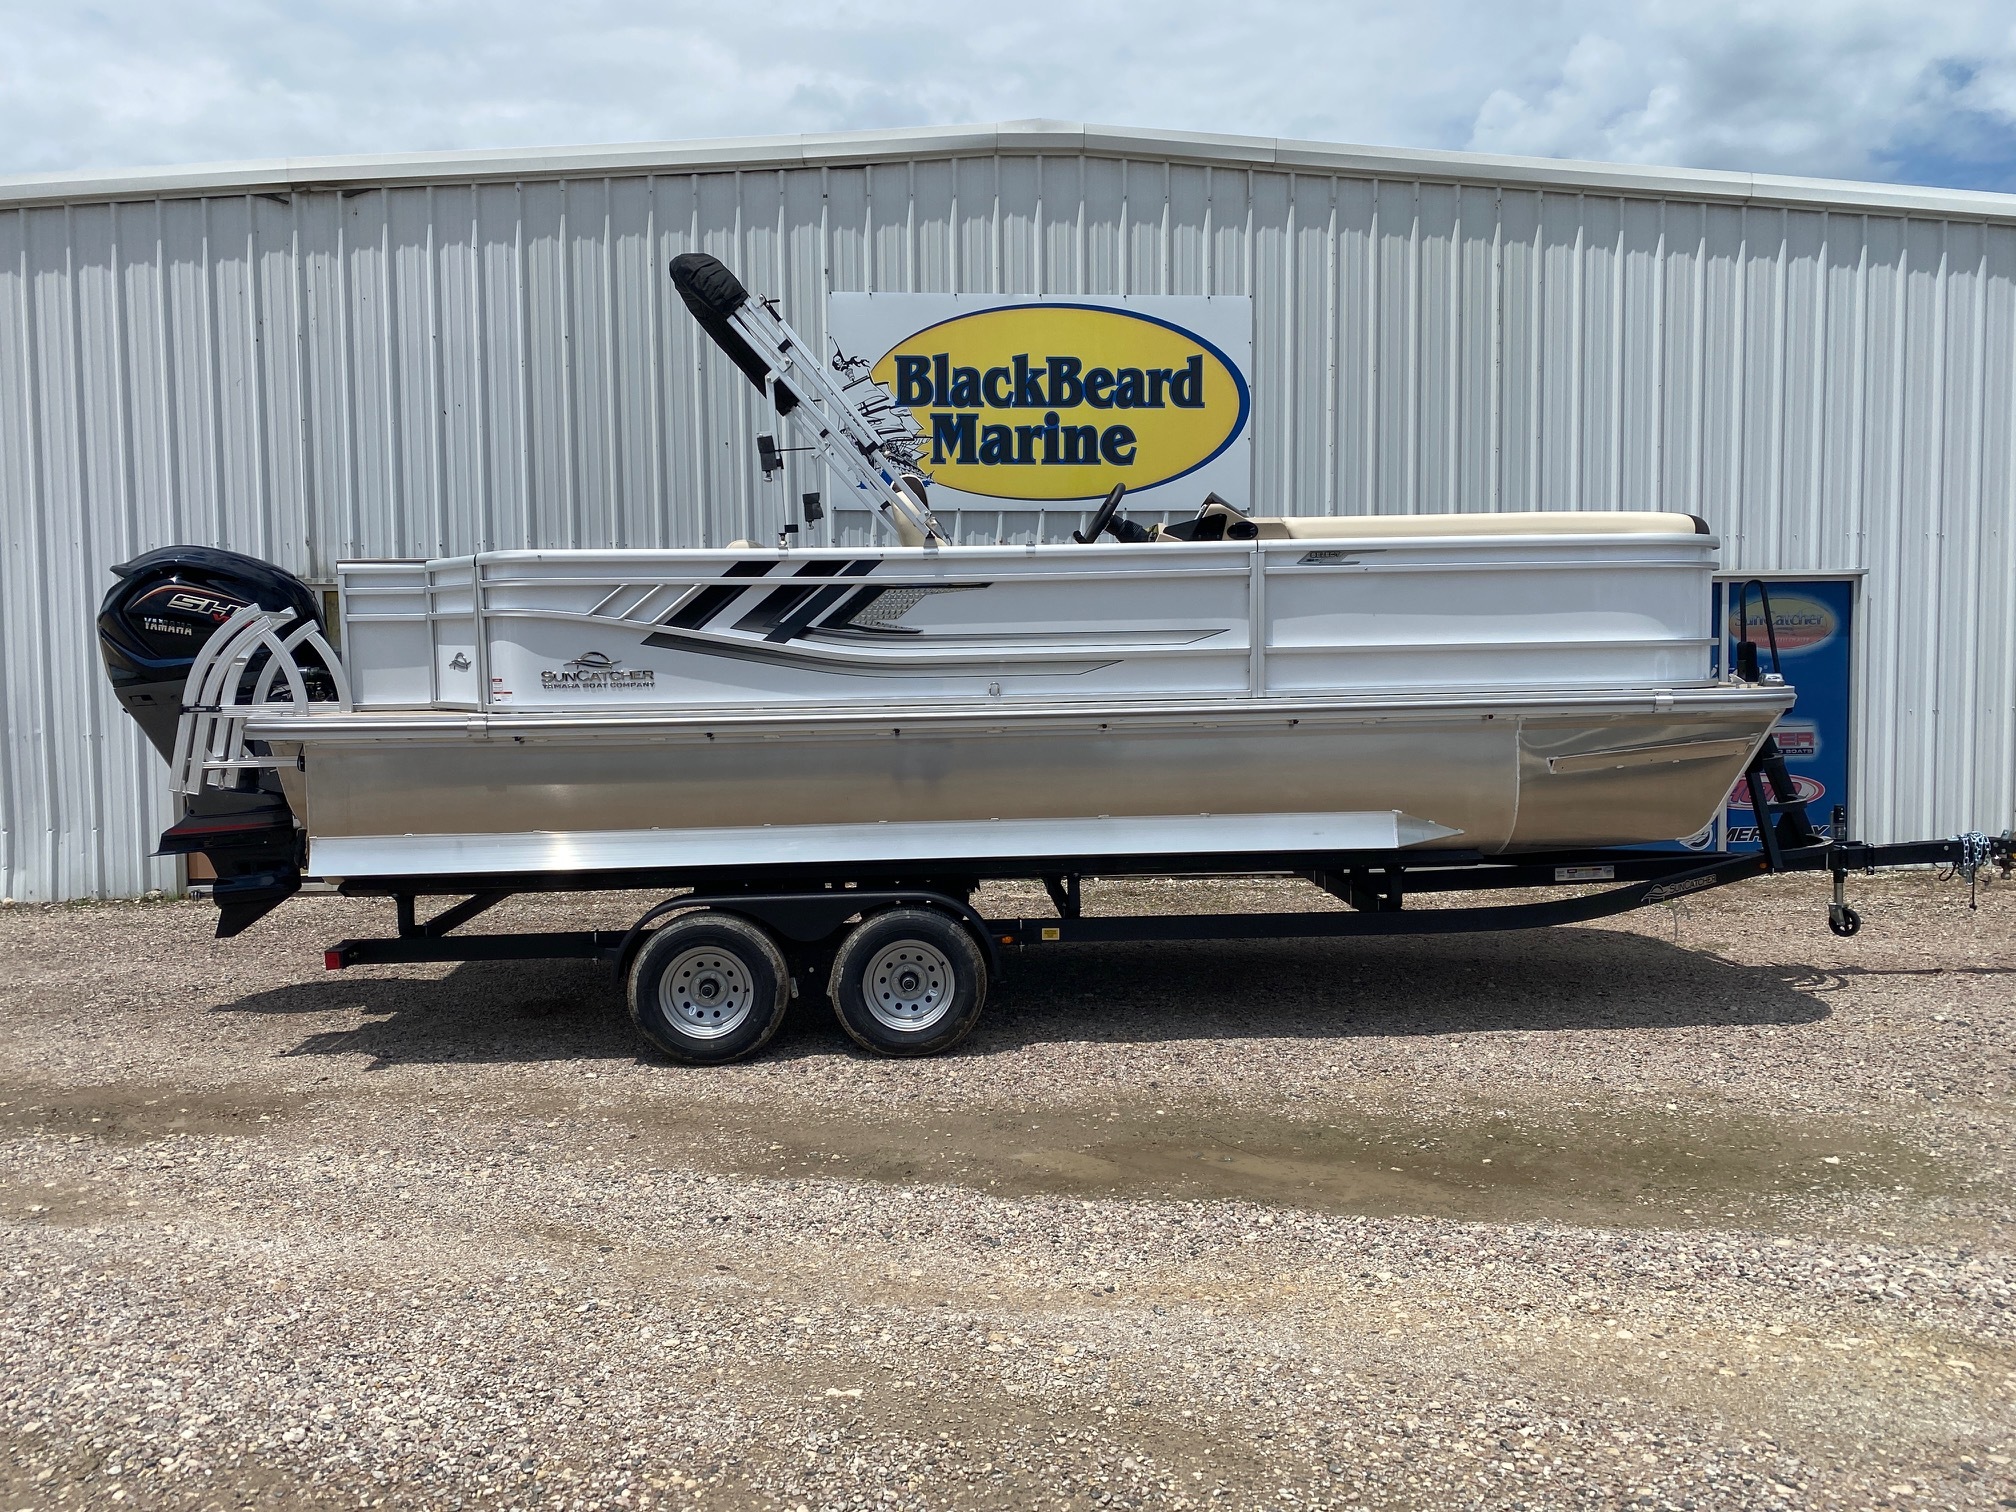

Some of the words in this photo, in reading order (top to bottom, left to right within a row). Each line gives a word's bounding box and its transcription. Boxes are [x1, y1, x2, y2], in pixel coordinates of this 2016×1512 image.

[894, 352, 1206, 409] BlackBeard
[929, 411, 1138, 466] Marine
[167, 593, 246, 615] SH
[144, 617, 193, 636] YAMAHA
[542, 682, 581, 690] YAMAHA
